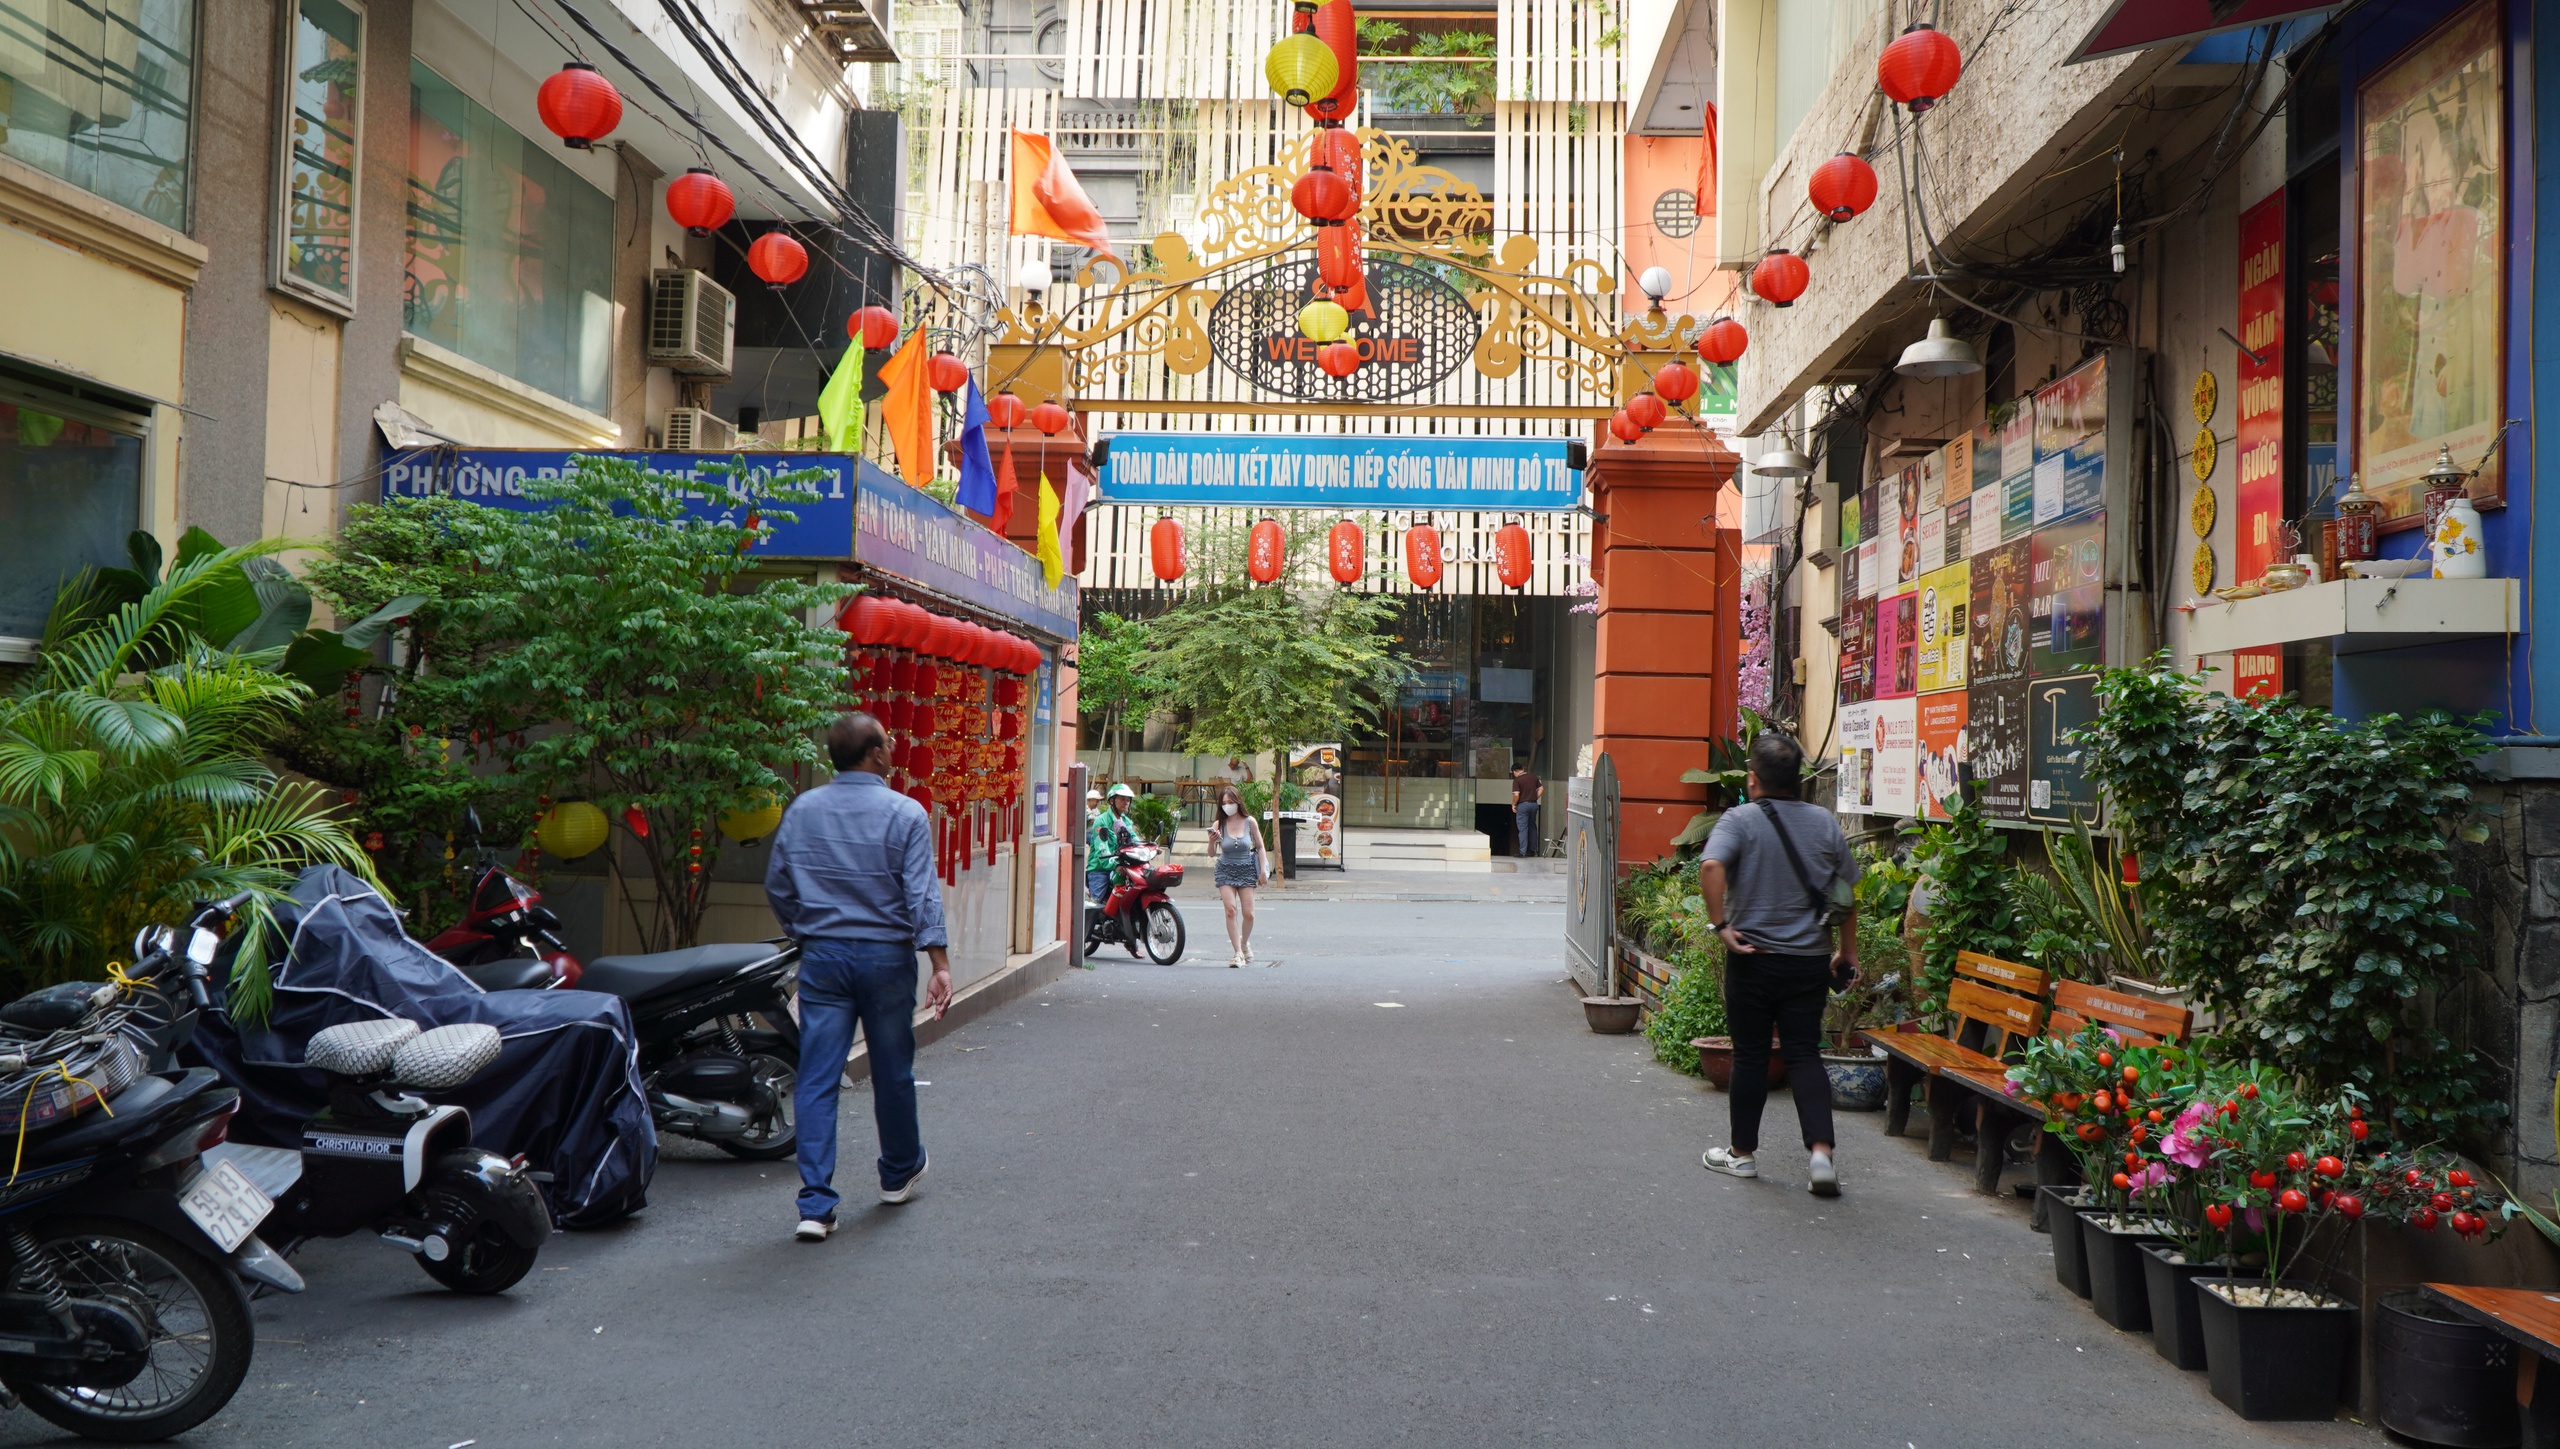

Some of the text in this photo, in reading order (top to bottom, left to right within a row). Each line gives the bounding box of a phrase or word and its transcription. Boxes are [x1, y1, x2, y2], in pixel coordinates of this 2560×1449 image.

[2243, 241, 2281, 292] NGÀN
[2245, 310, 2275, 352] NĂM
[2242, 375, 2278, 421] VỮNG
[2042, 434, 2057, 457] BAR
[2241, 435, 2278, 485] BƯỚC
[388, 456, 526, 497] PHƯỜNG
[829, 468, 846, 499] 1
[1110, 446, 1572, 496] TOÀN DÂN ĐOÀN KẾT XÂY DỰNG NẾP SỐNG VĂN MINH ĐÔ THỊ
[858, 487, 878, 537] AN
[880, 495, 916, 554] TOÀN
[923, 516, 948, 568] VĂN
[949, 534, 977, 581] MINH
[984, 549, 1009, 594] PHÁT
[1010, 557, 1036, 606] TRIỂN
[1921, 518, 1942, 541] SECRET
[2253, 511, 2268, 547] ĐI
[1989, 551, 2012, 573] POWER
[2033, 558, 2054, 584] MIU
[2032, 594, 2052, 619] BAR
[315, 1138, 390, 1154] CHRISTIAN DIOR
[190, 1170, 239, 1218] 59-V3
[210, 1187, 265, 1246] 279.17
